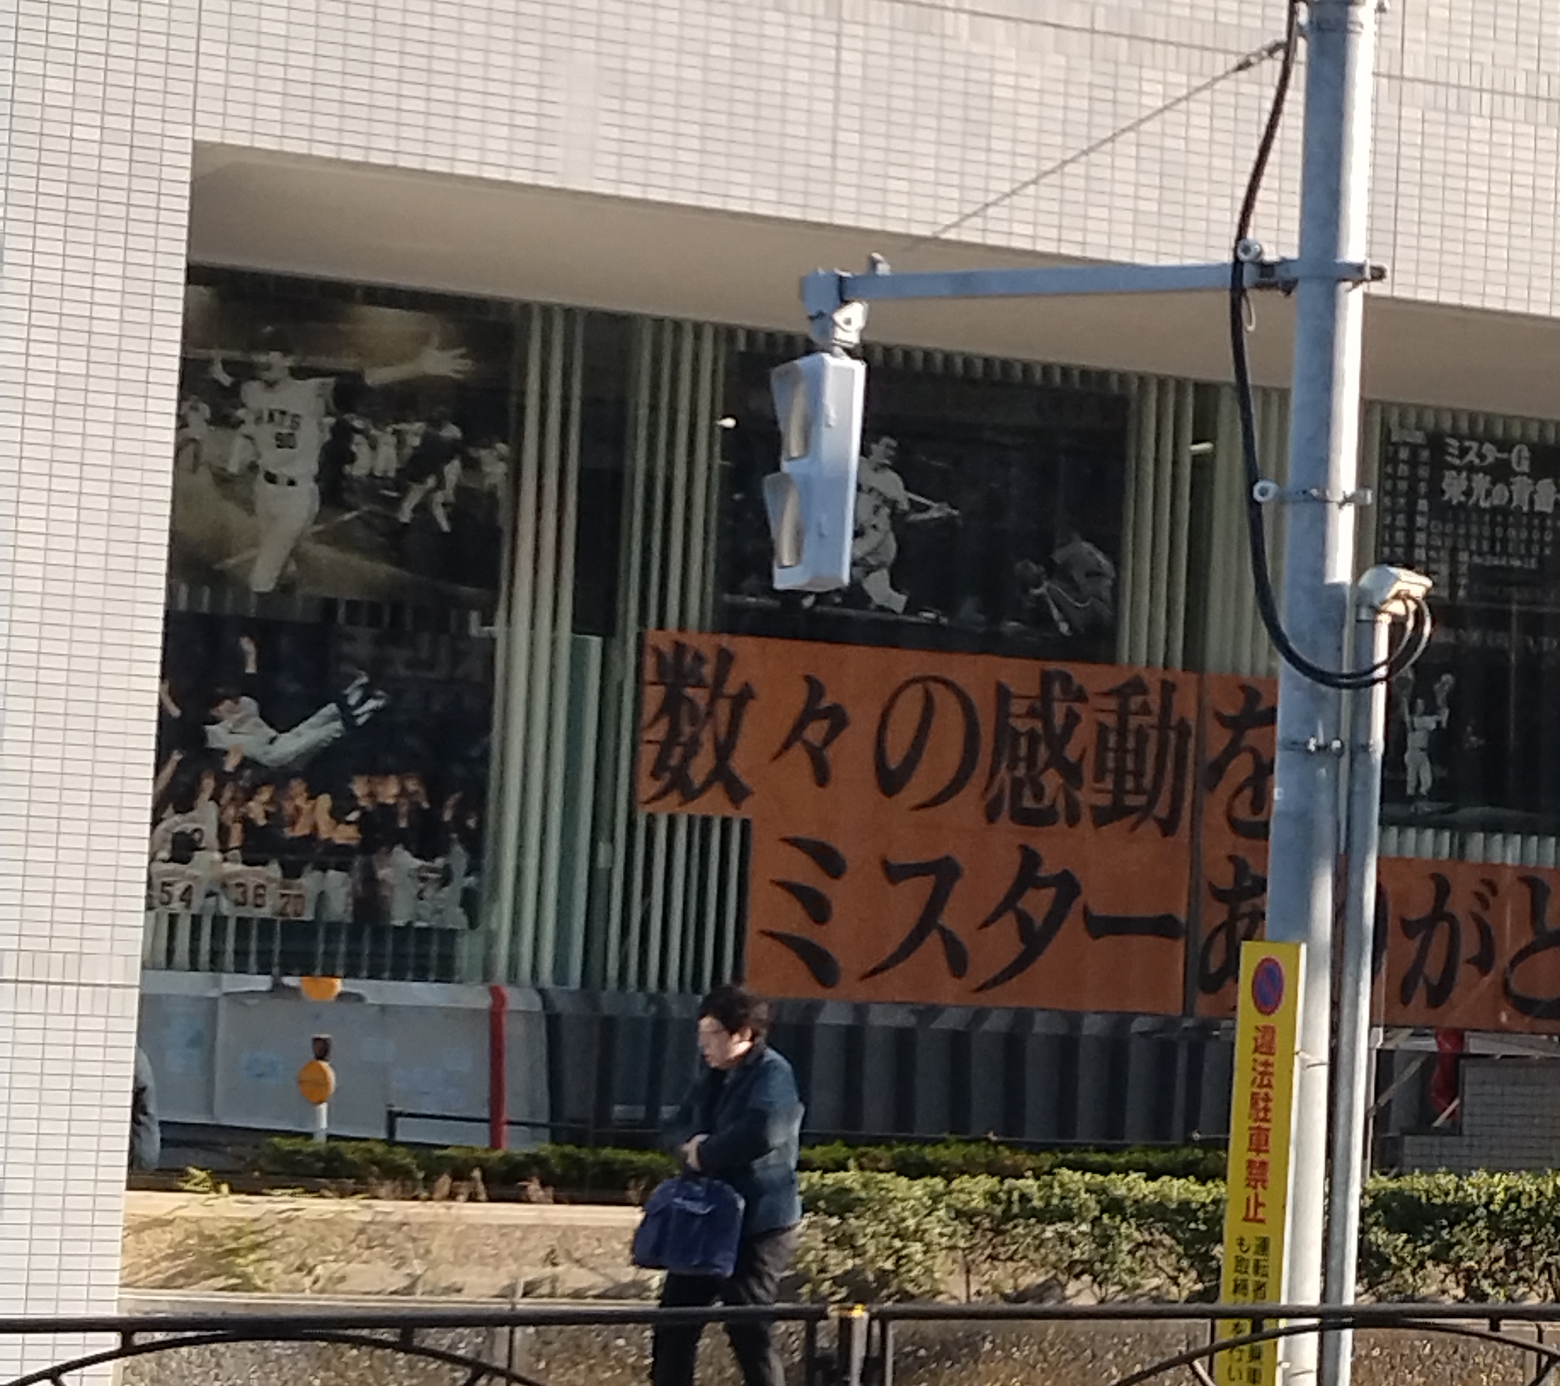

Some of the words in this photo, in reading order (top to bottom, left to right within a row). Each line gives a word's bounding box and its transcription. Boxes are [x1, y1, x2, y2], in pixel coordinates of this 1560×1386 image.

[640, 639, 1278, 840] 数々の感動を
[159, 881, 194, 910] 54
[1241, 1023, 1278, 1225] 違法駐車禁止
